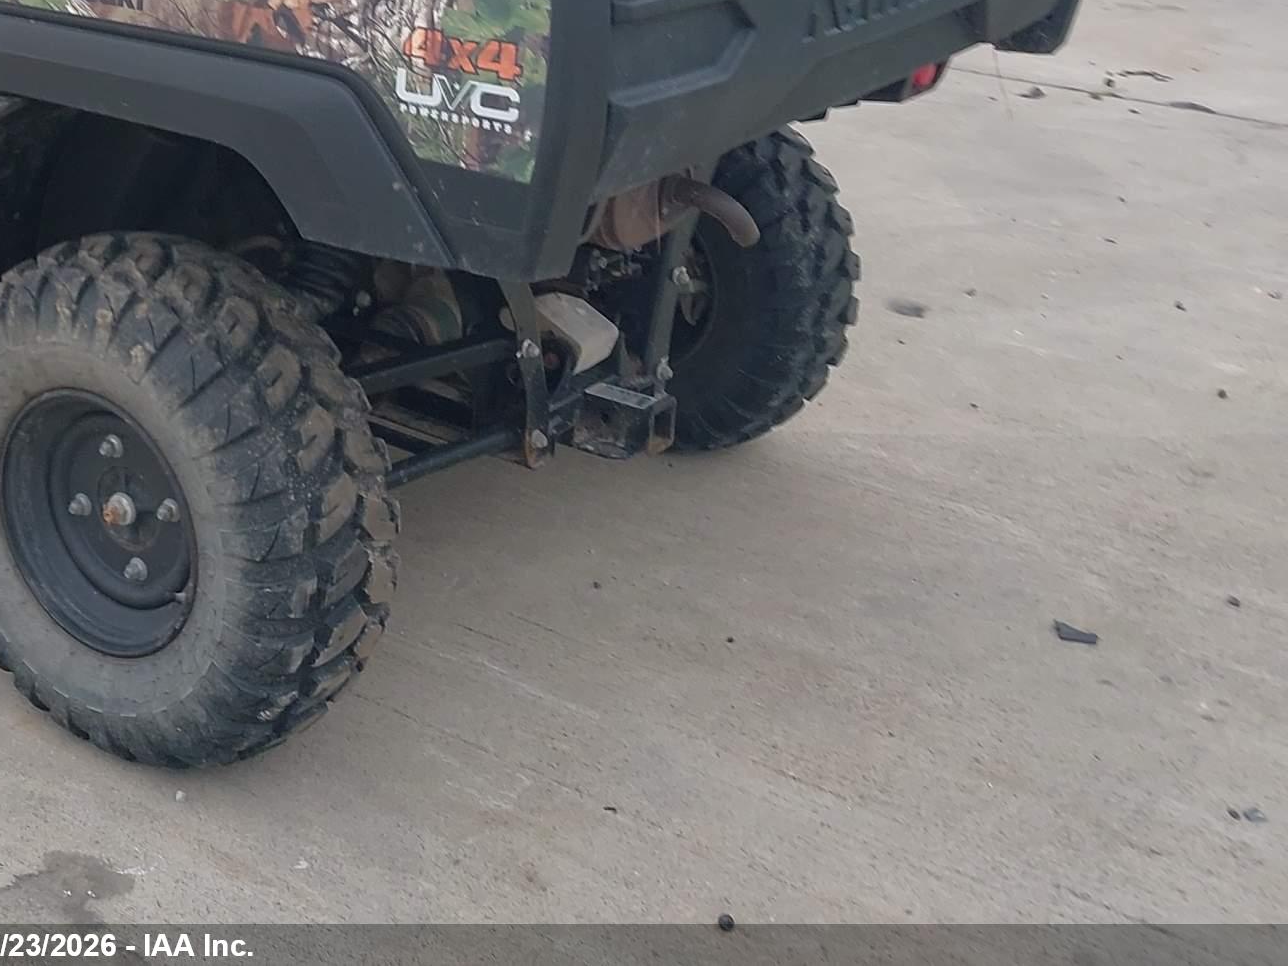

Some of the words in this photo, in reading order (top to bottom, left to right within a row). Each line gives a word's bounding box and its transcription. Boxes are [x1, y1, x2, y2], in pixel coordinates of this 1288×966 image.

[403, 26, 523, 81] 4x4
[395, 66, 521, 123] UVC
[398, 102, 512, 135] POWERSPORTS
